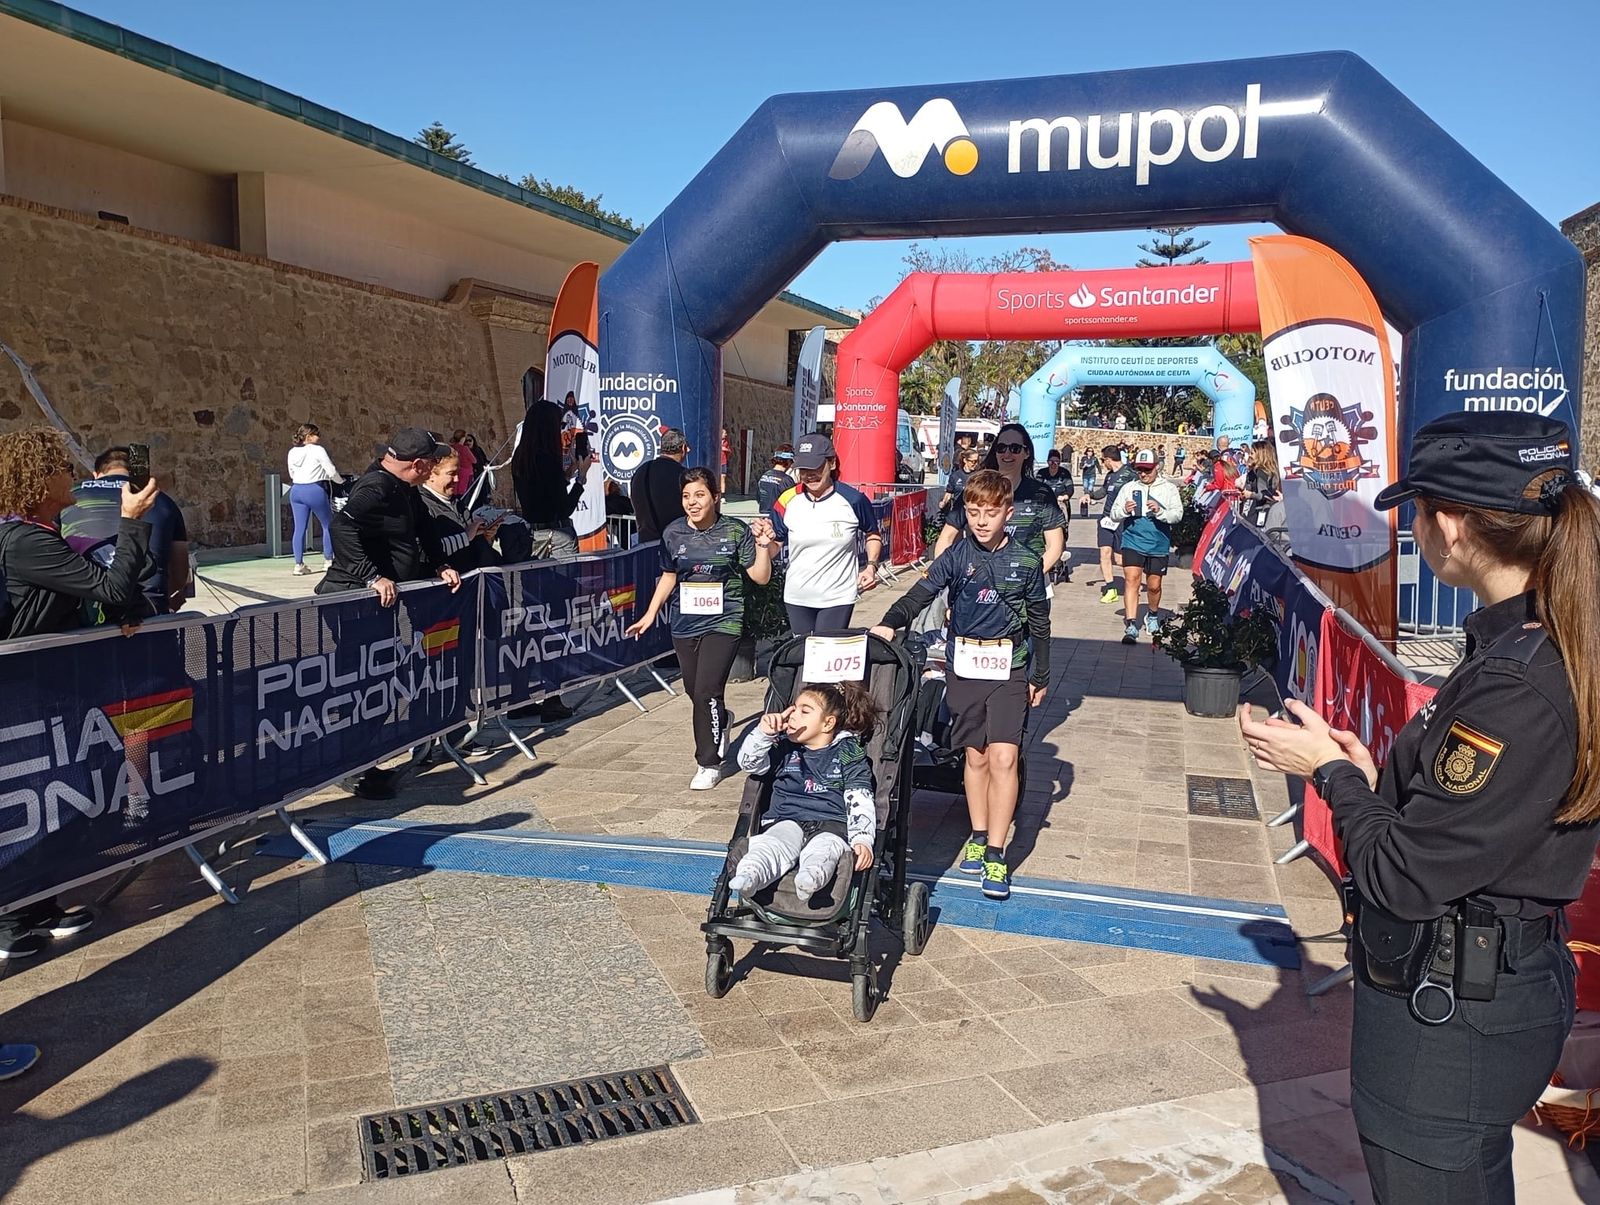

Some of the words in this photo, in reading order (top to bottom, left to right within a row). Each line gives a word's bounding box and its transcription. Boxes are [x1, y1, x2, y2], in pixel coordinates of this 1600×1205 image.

[1008, 84, 1261, 185] mupol
[997, 289, 1064, 314] Sports
[1100, 284, 1219, 307] Santander
[1064, 316, 1138, 325] sportssantander.es
[553, 353, 597, 374] MOTOCLUB
[1080, 357, 1119, 365] INSTITUTO
[1145, 357, 1155, 365] DE
[1157, 356, 1198, 365] DEPORTES
[599, 372, 677, 393] undación
[1115, 369, 1154, 377] AUTÓNOMA
[1444, 367, 1565, 391] fundación
[845, 387, 874, 398] Sports
[602, 393, 656, 414] mupol
[843, 402, 887, 411] Santander
[1520, 451, 1570, 463] NACIONAL
[693, 597, 720, 607] 1064
[499, 616, 638, 673] NACIONAL
[825, 656, 861, 672] 1075
[972, 656, 1008, 670] 1038
[257, 660, 459, 760] NACIONAL
[711, 708, 720, 744] adidas
[1445, 768, 1488, 791] NACIONAL
